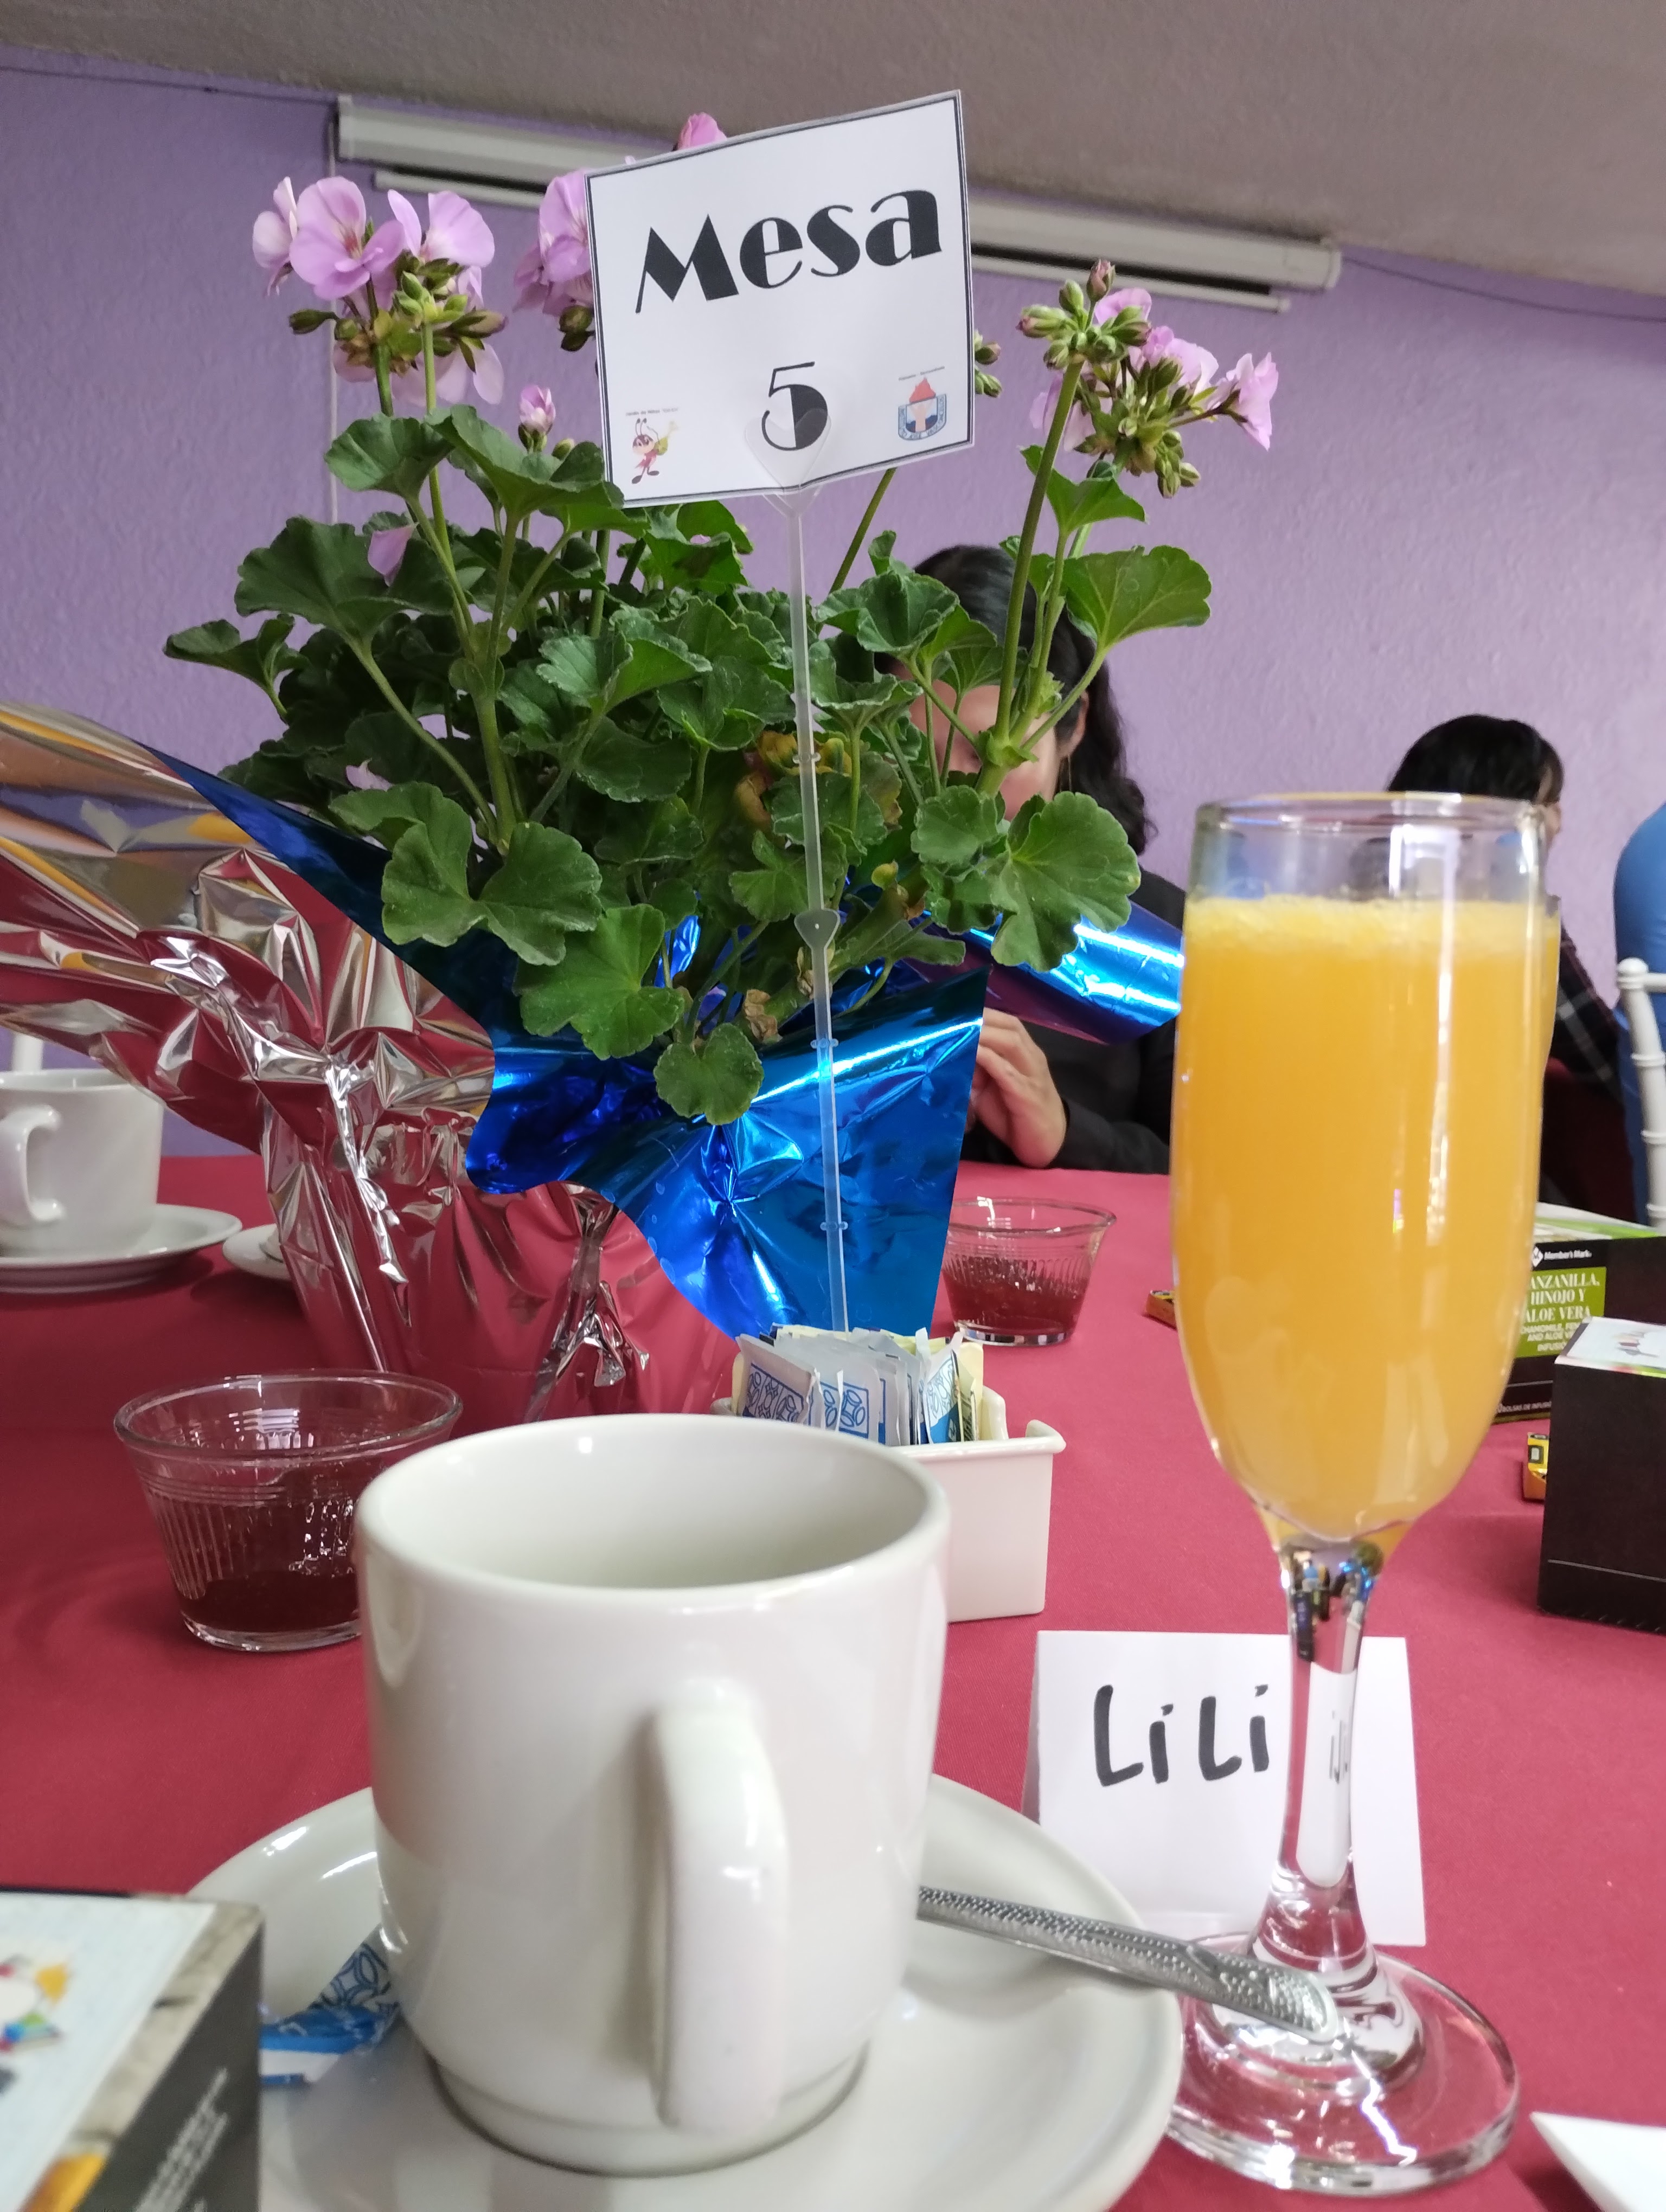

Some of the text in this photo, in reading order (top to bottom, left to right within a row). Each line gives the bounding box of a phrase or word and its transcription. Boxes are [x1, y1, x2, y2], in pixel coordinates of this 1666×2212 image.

[635, 189, 943, 314] Mesa
[761, 361, 829, 451] 5
[1530, 1272, 1600, 1290] ANZANILLA,
[1530, 1288, 1586, 1306] HINOJO Y
[1559, 1306, 1591, 1320] VERA
